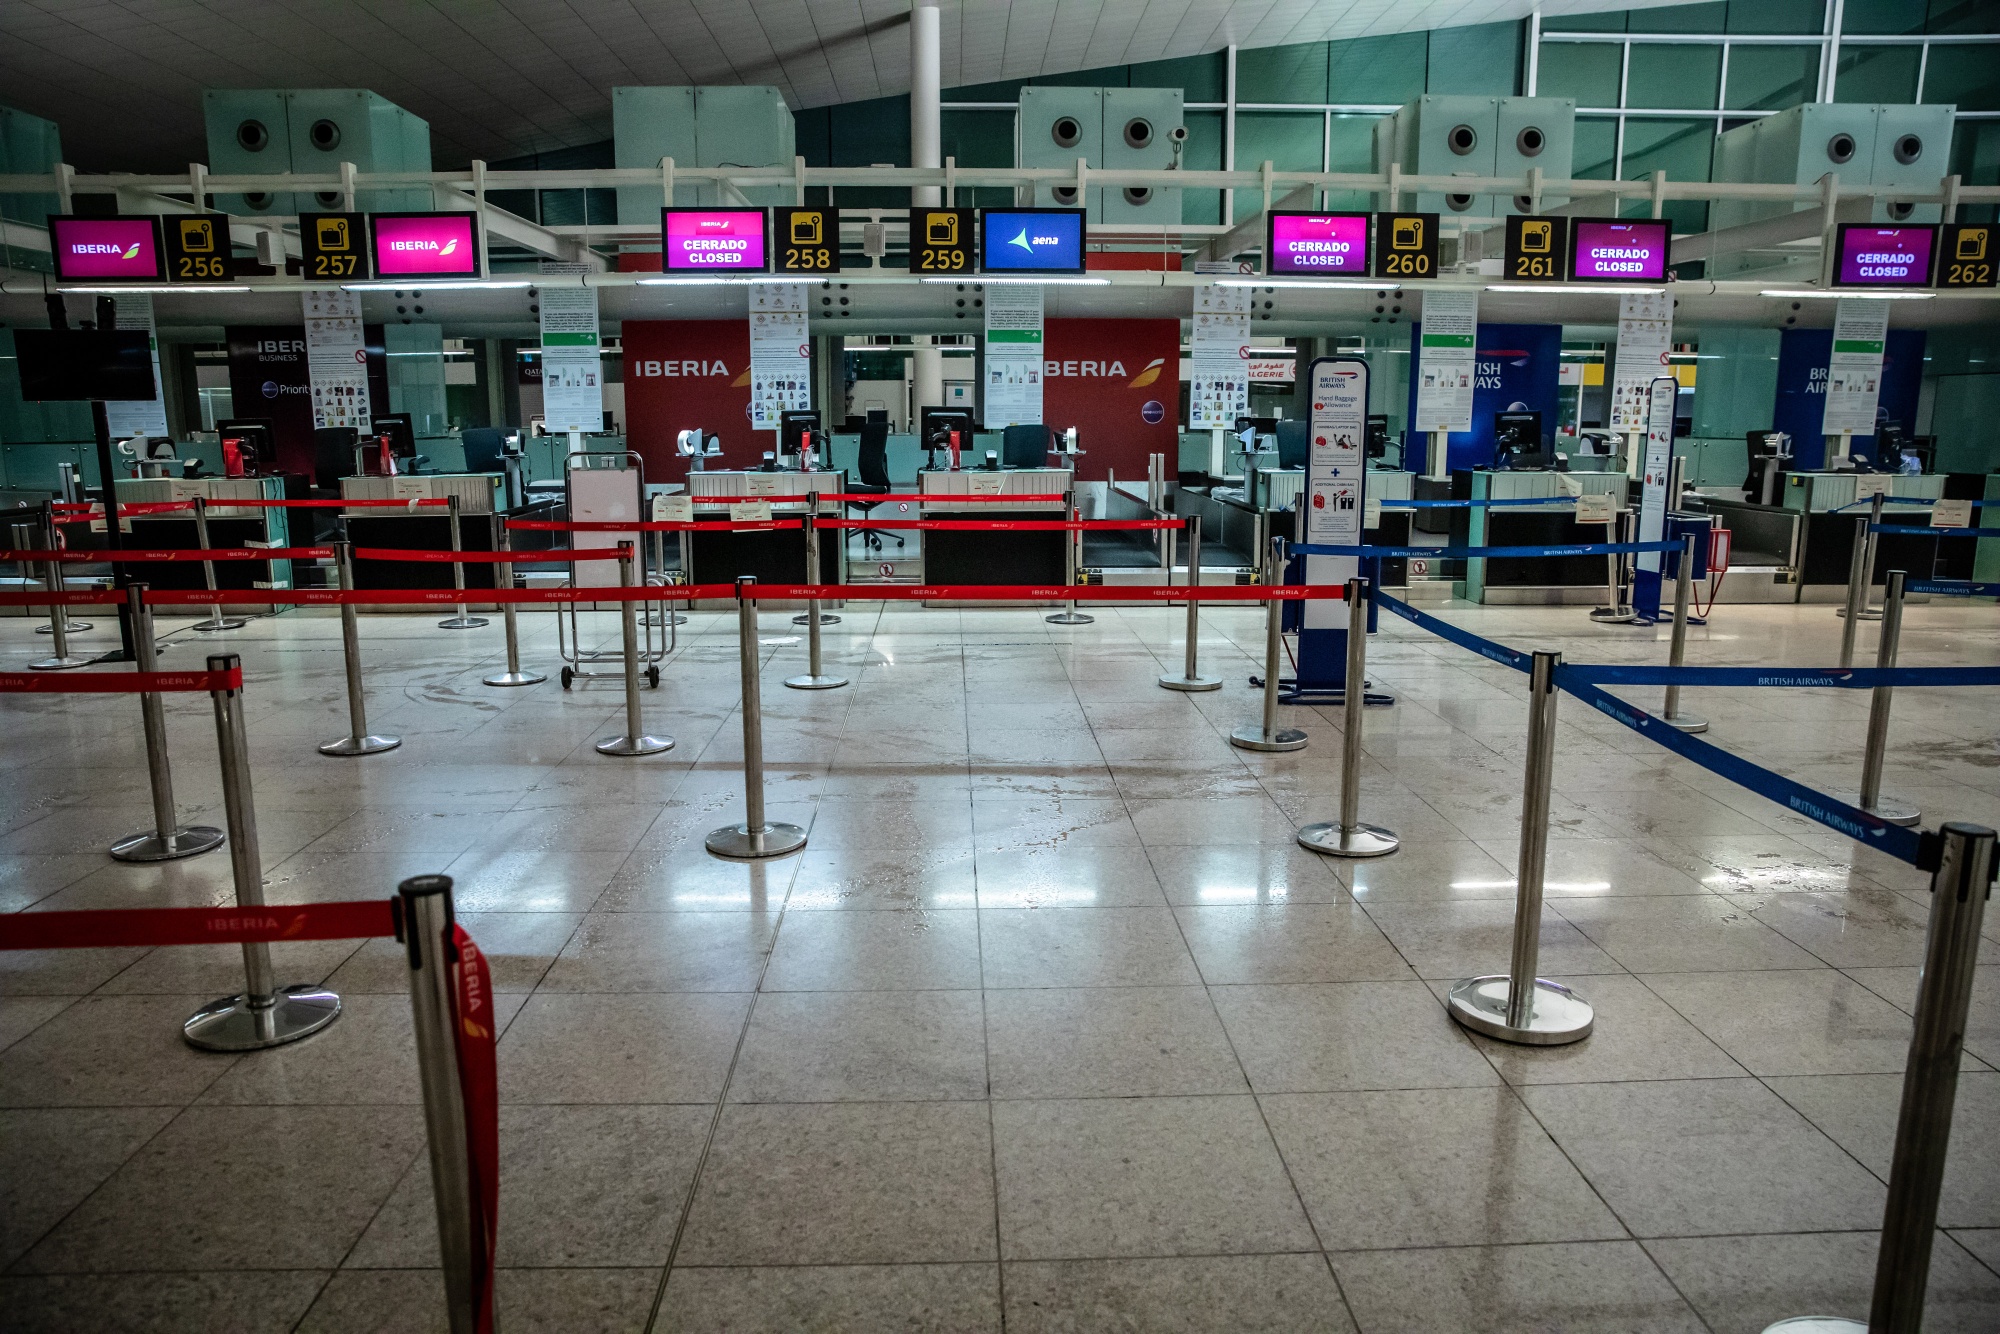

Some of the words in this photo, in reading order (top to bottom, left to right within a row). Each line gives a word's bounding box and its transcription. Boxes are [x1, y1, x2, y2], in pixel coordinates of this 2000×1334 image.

[391, 241, 439, 250] IBERIA
[683, 239, 747, 250] CERRADO
[1032, 236, 1059, 245] aena
[72, 244, 122, 254] IBERIA
[1288, 241, 1350, 253] CERRADO
[689, 253, 742, 263] CLOSED
[785, 249, 831, 269] 258
[921, 250, 965, 270] 259
[1591, 248, 1650, 260] CERRADO
[1856, 253, 1915, 264] CERRADO
[315, 255, 357, 275] 257
[1293, 255, 1344, 266] CLOSED
[1386, 254, 1429, 274] 260
[1516, 256, 1554, 277] 261
[179, 257, 224, 277] 256
[1595, 261, 1644, 273] CLOSED
[1859, 266, 1908, 277] CLOSED
[1948, 264, 1990, 283] 262
[257, 340, 306, 353] IBER
[259, 354, 298, 362] BUSINESS
[524, 368, 543, 376] QAT
[635, 360, 729, 377] IBERIA
[1043, 360, 1127, 377] BERIA
[0, 678, 25, 686] ERIA
[157, 677, 195, 685] IBERIA
[1758, 677, 1794, 686] BRITISH
[1795, 677, 1834, 686] AIRWAYS
[1596, 698, 1616, 716] BRITISH
[1616, 710, 1637, 728] AIRWAYS
[1790, 795, 1824, 821] BRITISH
[1825, 812, 1864, 838] AIRWAYS
[206, 917, 280, 931] IBERIA
[461, 939, 482, 1013] IBERIA
